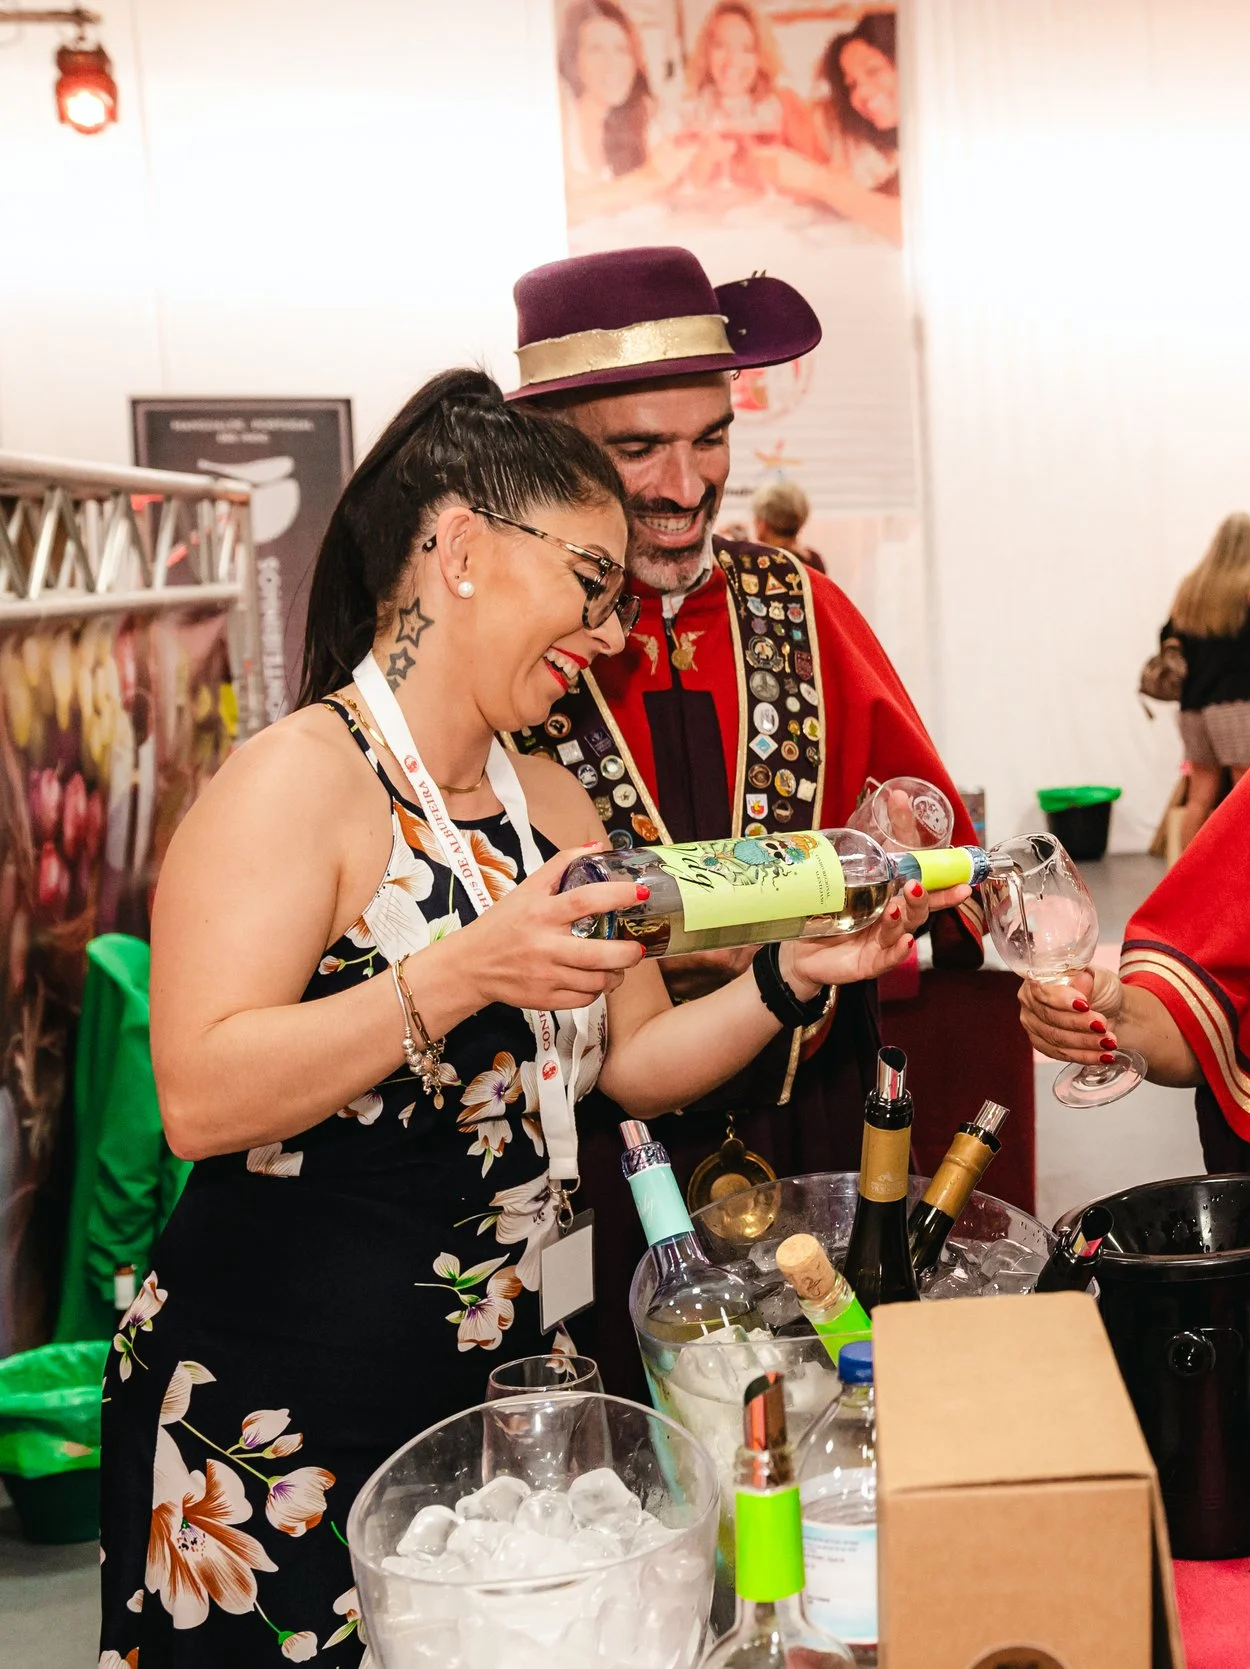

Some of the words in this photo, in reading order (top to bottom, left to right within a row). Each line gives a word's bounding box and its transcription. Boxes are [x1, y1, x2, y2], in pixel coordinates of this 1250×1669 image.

[418, 780, 466, 856] ALBUFEIRA
[457, 857, 474, 880] DE
[468, 880, 491, 911] HUS
[538, 1010, 551, 1052] CONF
